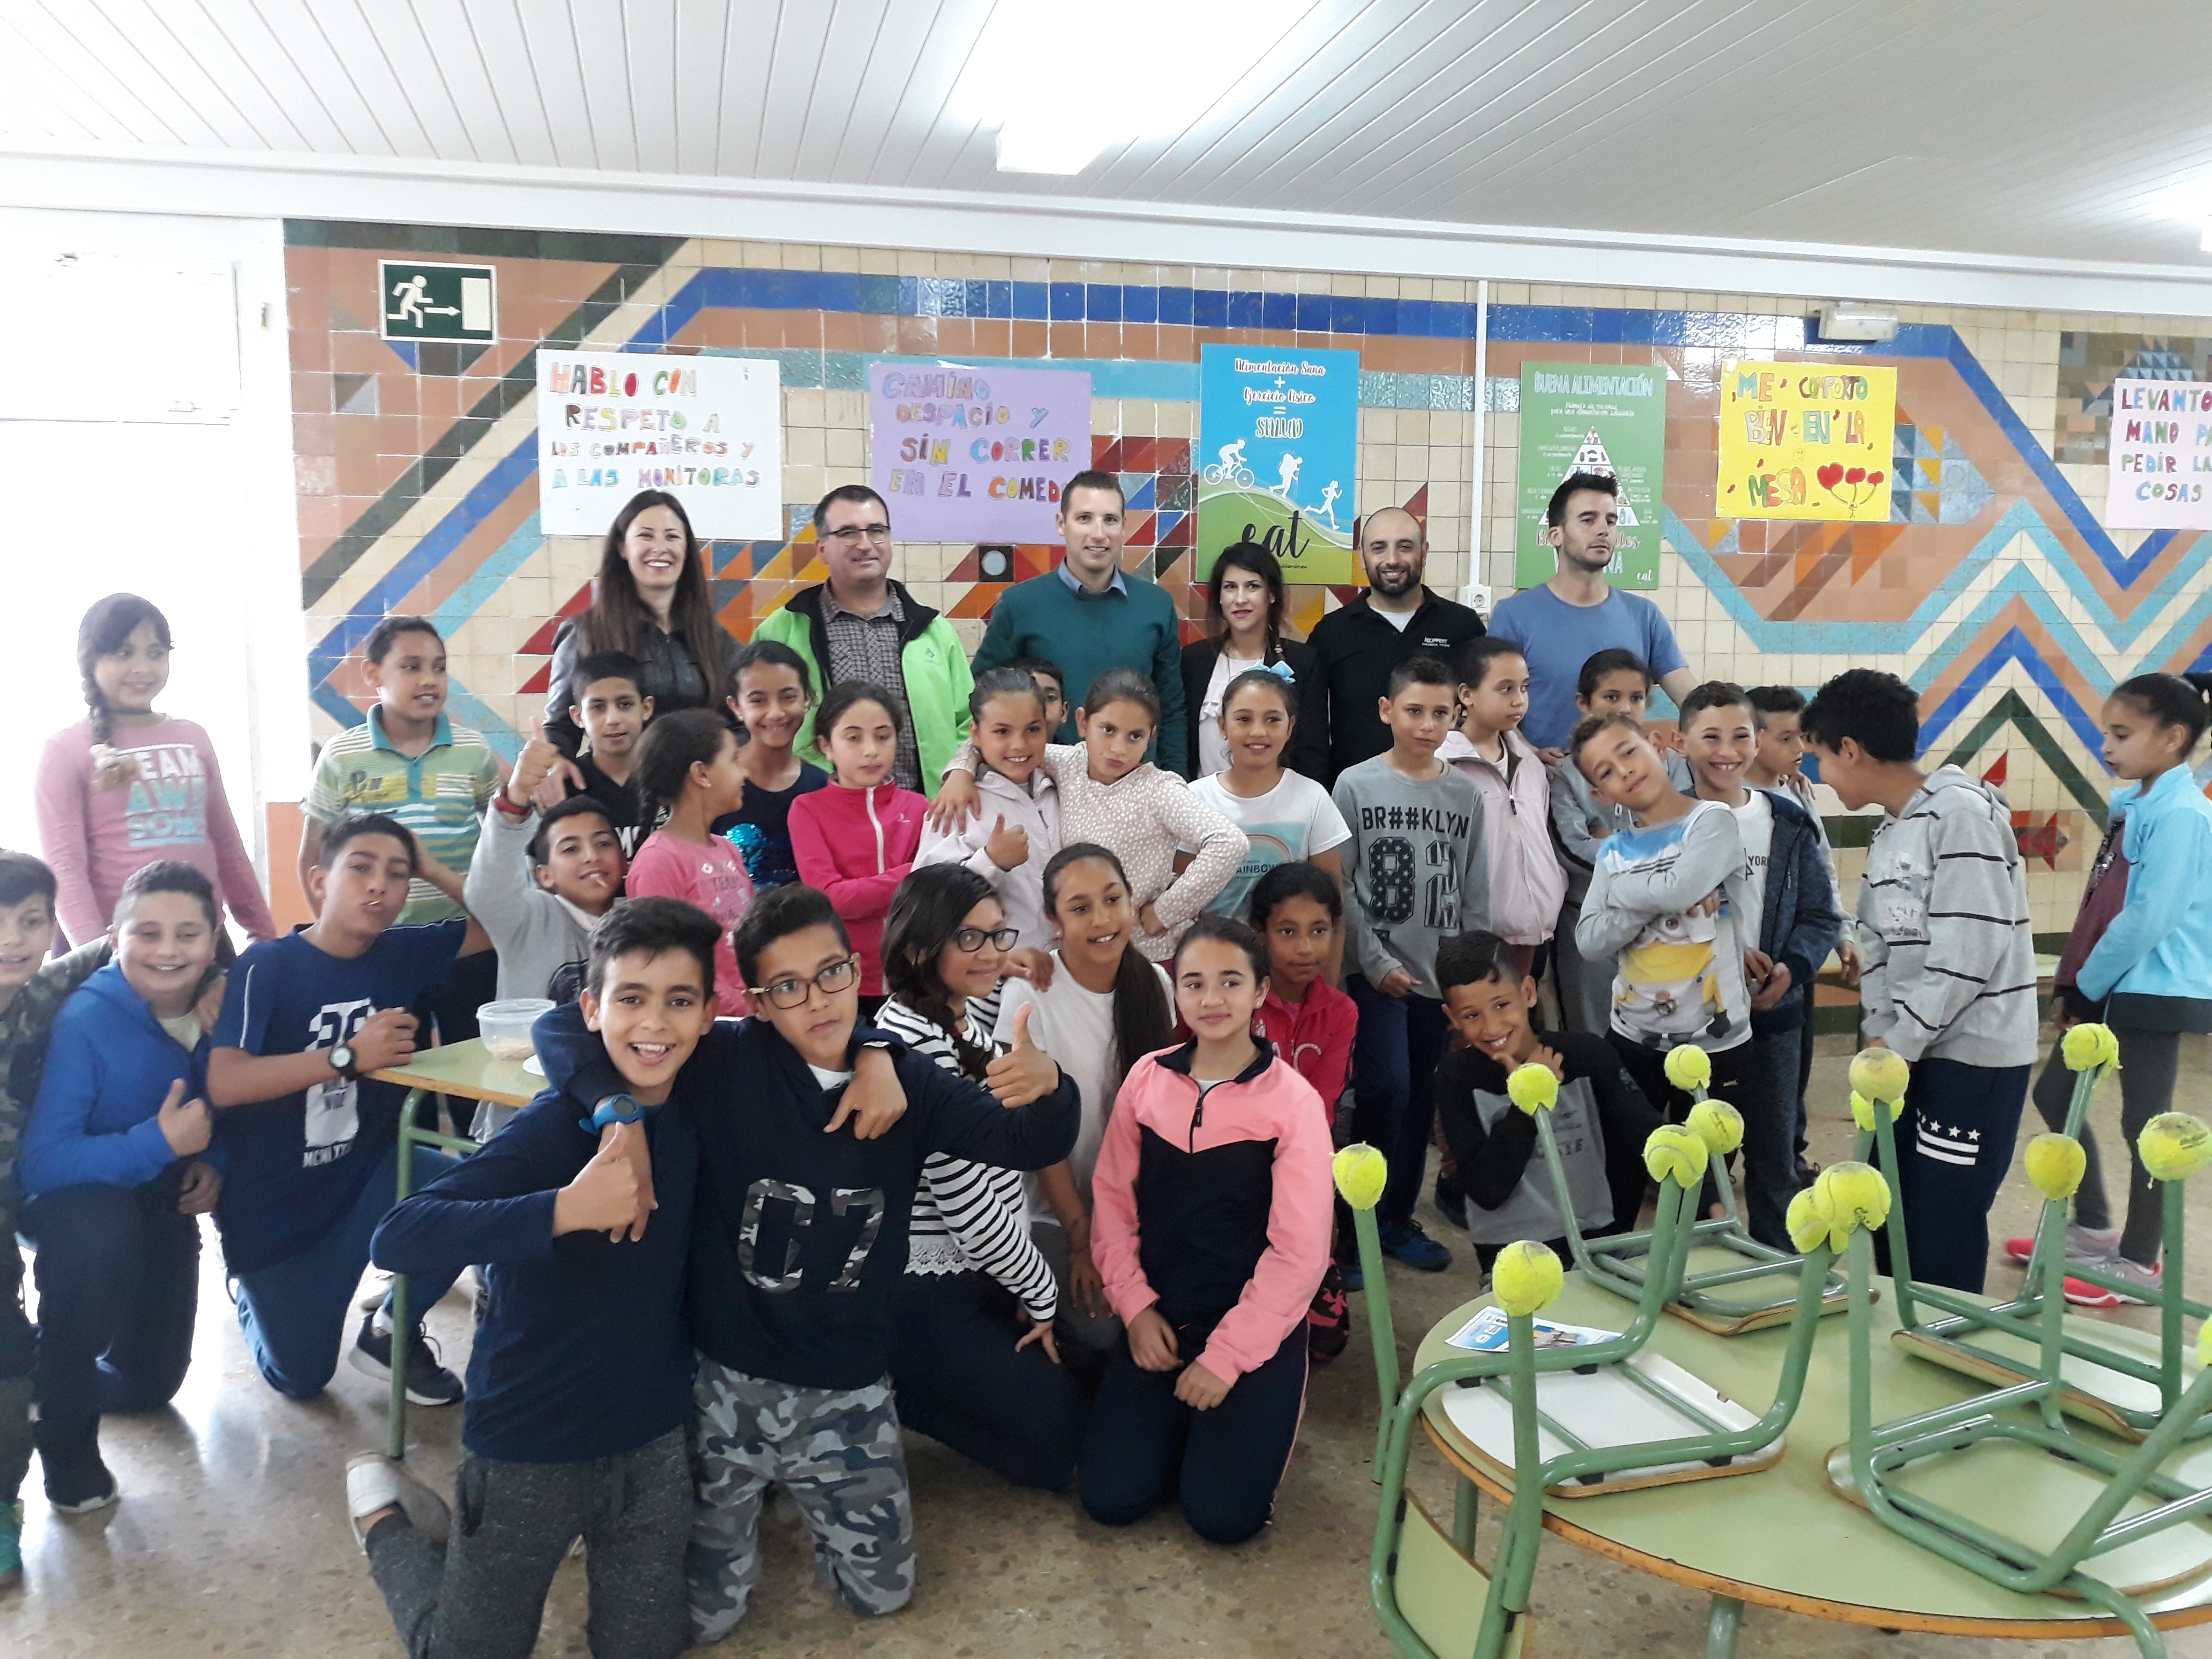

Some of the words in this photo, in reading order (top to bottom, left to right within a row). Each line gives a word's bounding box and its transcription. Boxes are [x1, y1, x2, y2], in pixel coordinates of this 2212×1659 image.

[549, 362, 639, 397] HABLO
[653, 368, 697, 397] CON
[1301, 361, 1326, 376] Sana
[883, 372, 990, 400] CAMINO
[1244, 387, 1287, 405] Ejercicio
[1534, 371, 1570, 394] BUENA
[1571, 372, 1653, 397] ALIMENTACIÓN
[1799, 375, 1868, 400] COMPORTO
[2121, 387, 2212, 412] LEVANTO
[565, 404, 686, 431] RESPETO
[703, 413, 720, 433] A
[897, 401, 1010, 428] DESPACIO
[1030, 408, 1049, 427] Y
[1744, 405, 1788, 446] BIEN
[1803, 410, 1830, 444] EN
[1845, 410, 1864, 445] LA
[1255, 416, 1304, 439] SALUD
[2125, 419, 2180, 444] MANO
[551, 441, 580, 457] LOS
[589, 434, 728, 458] COMPAÑEROS
[741, 442, 755, 459] Y
[900, 432, 950, 465] SIN
[971, 437, 1070, 462] CORRER
[2122, 452, 2177, 473] PEDIR
[552, 468, 567, 488] A
[578, 468, 618, 487] LAS
[637, 464, 760, 488] MONITORAS
[889, 469, 925, 495] EN
[938, 472, 972, 497] EL
[989, 476, 1065, 502] COMED
[1748, 466, 1806, 508] MESA
[2136, 481, 2202, 502] COSAS
[133, 748, 205, 781] EAM
[1362, 806, 1469, 839] BR##KLYN
[1236, 864, 1280, 874] AINBO
[1748, 855, 1767, 866] YOR
